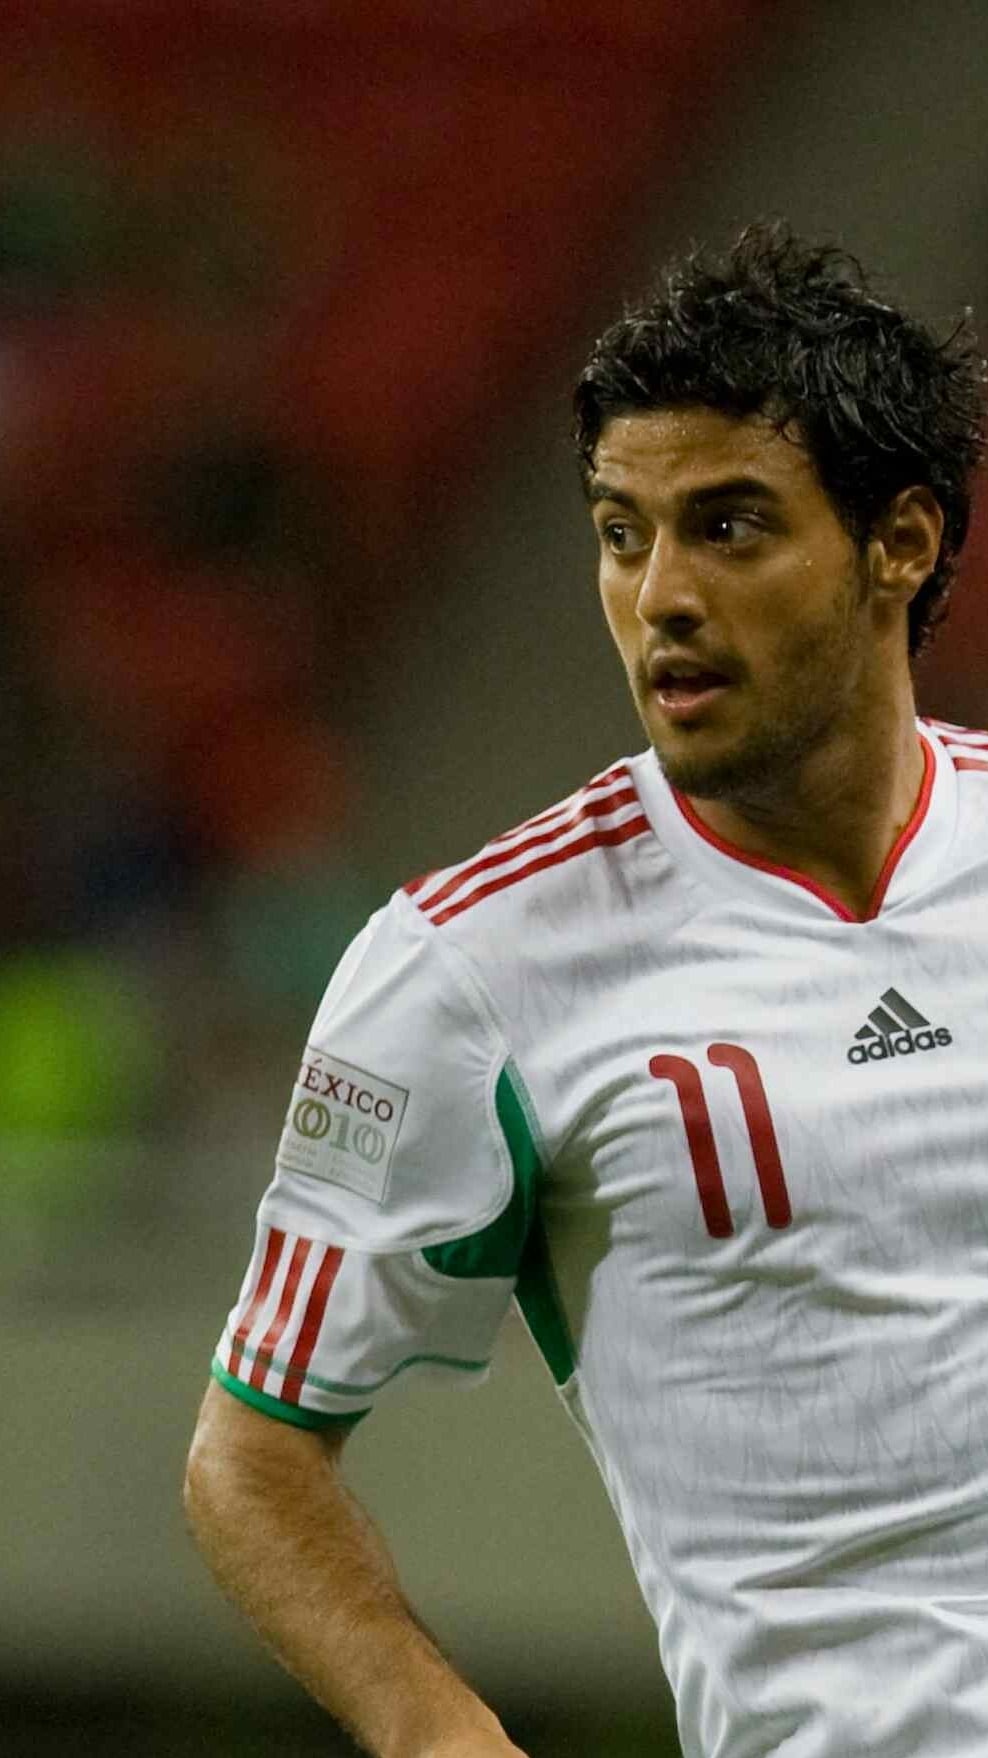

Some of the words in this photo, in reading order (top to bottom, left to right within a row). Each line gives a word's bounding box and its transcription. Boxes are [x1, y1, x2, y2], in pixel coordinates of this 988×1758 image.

[847, 1028, 952, 1064] adidas
[299, 1058, 393, 1122] ÉXICO
[292, 1098, 386, 1165] 010
[649, 1043, 792, 1238] 11
